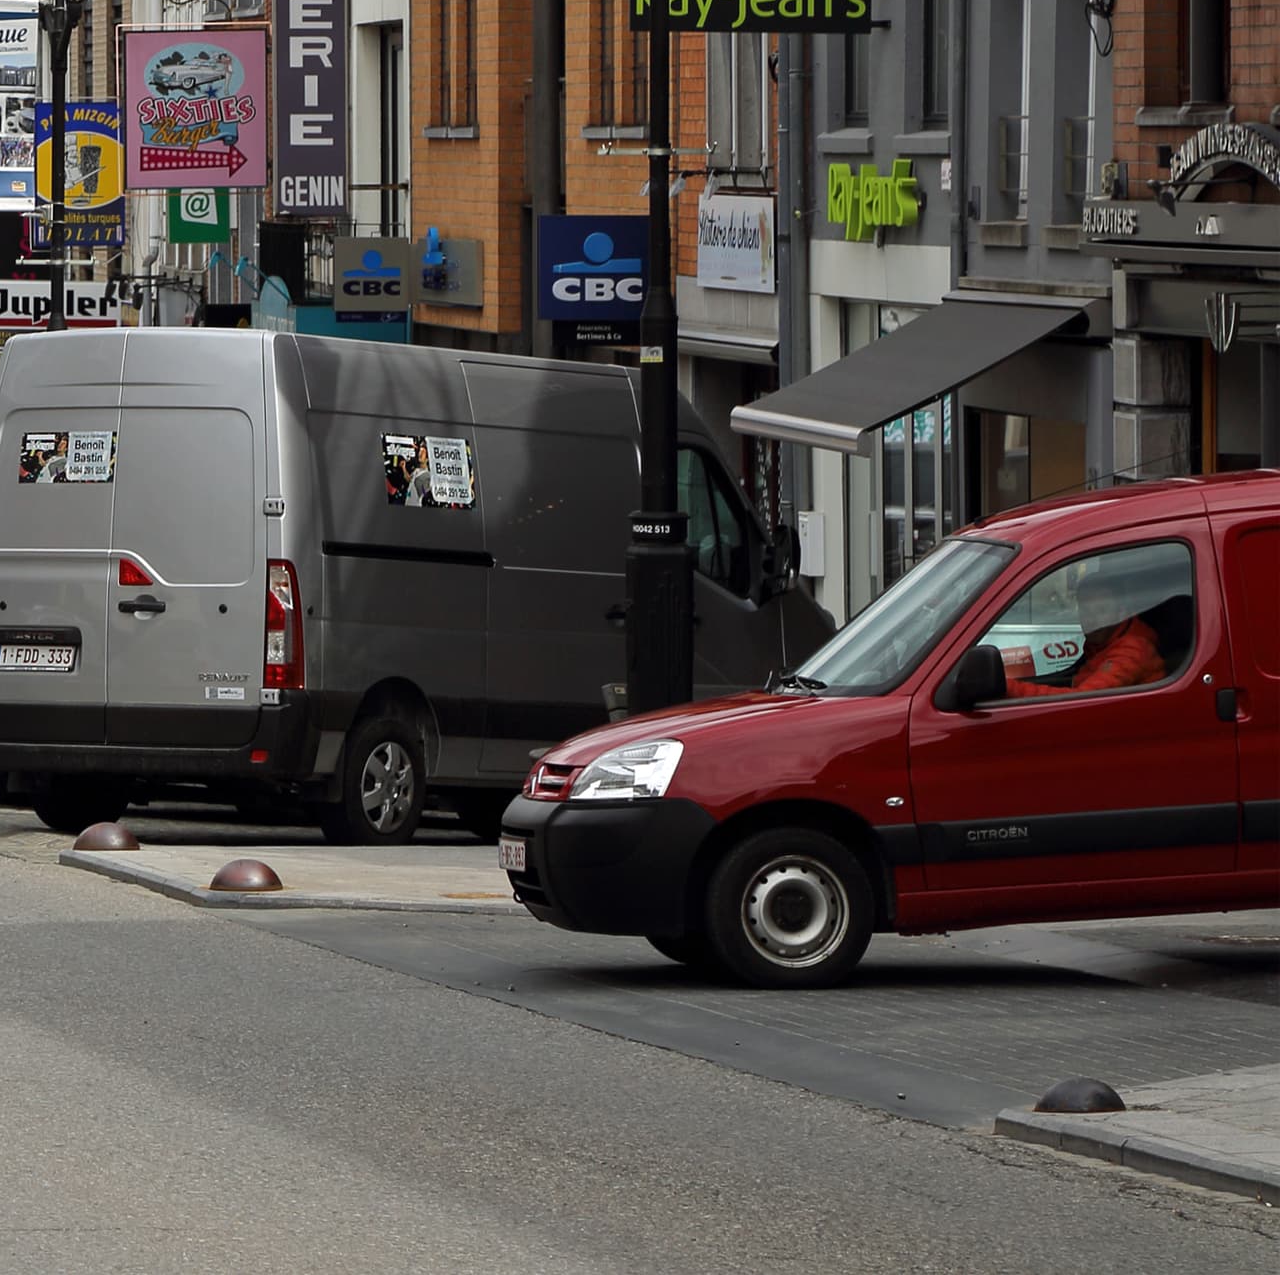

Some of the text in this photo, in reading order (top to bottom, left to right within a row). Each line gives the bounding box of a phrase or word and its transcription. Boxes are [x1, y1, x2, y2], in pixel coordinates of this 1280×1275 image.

[137, 95, 256, 124] SIXTIES
[72, 108, 120, 130] MIZGIN
[150, 117, 220, 152] Burger
[280, 175, 344, 208] GENIN
[88, 213, 120, 225] turques
[1082, 207, 1137, 236] BIJOUTIERS
[699, 210, 726, 247] Histoire
[727, 211, 737, 248] de
[342, 280, 402, 297] CBC
[552, 277, 643, 302] CBC
[74, 439, 105, 450] Benoît
[433, 446, 462, 460] Benoît
[74, 453, 104, 463] Bastin
[435, 462, 463, 477] Bastin
[654, 524, 671, 534] 513
[1, 647, 73, 665] 1-FDD-333
[198, 672, 252, 683] RENAULT
[967, 825, 1029, 841] CITROËN
